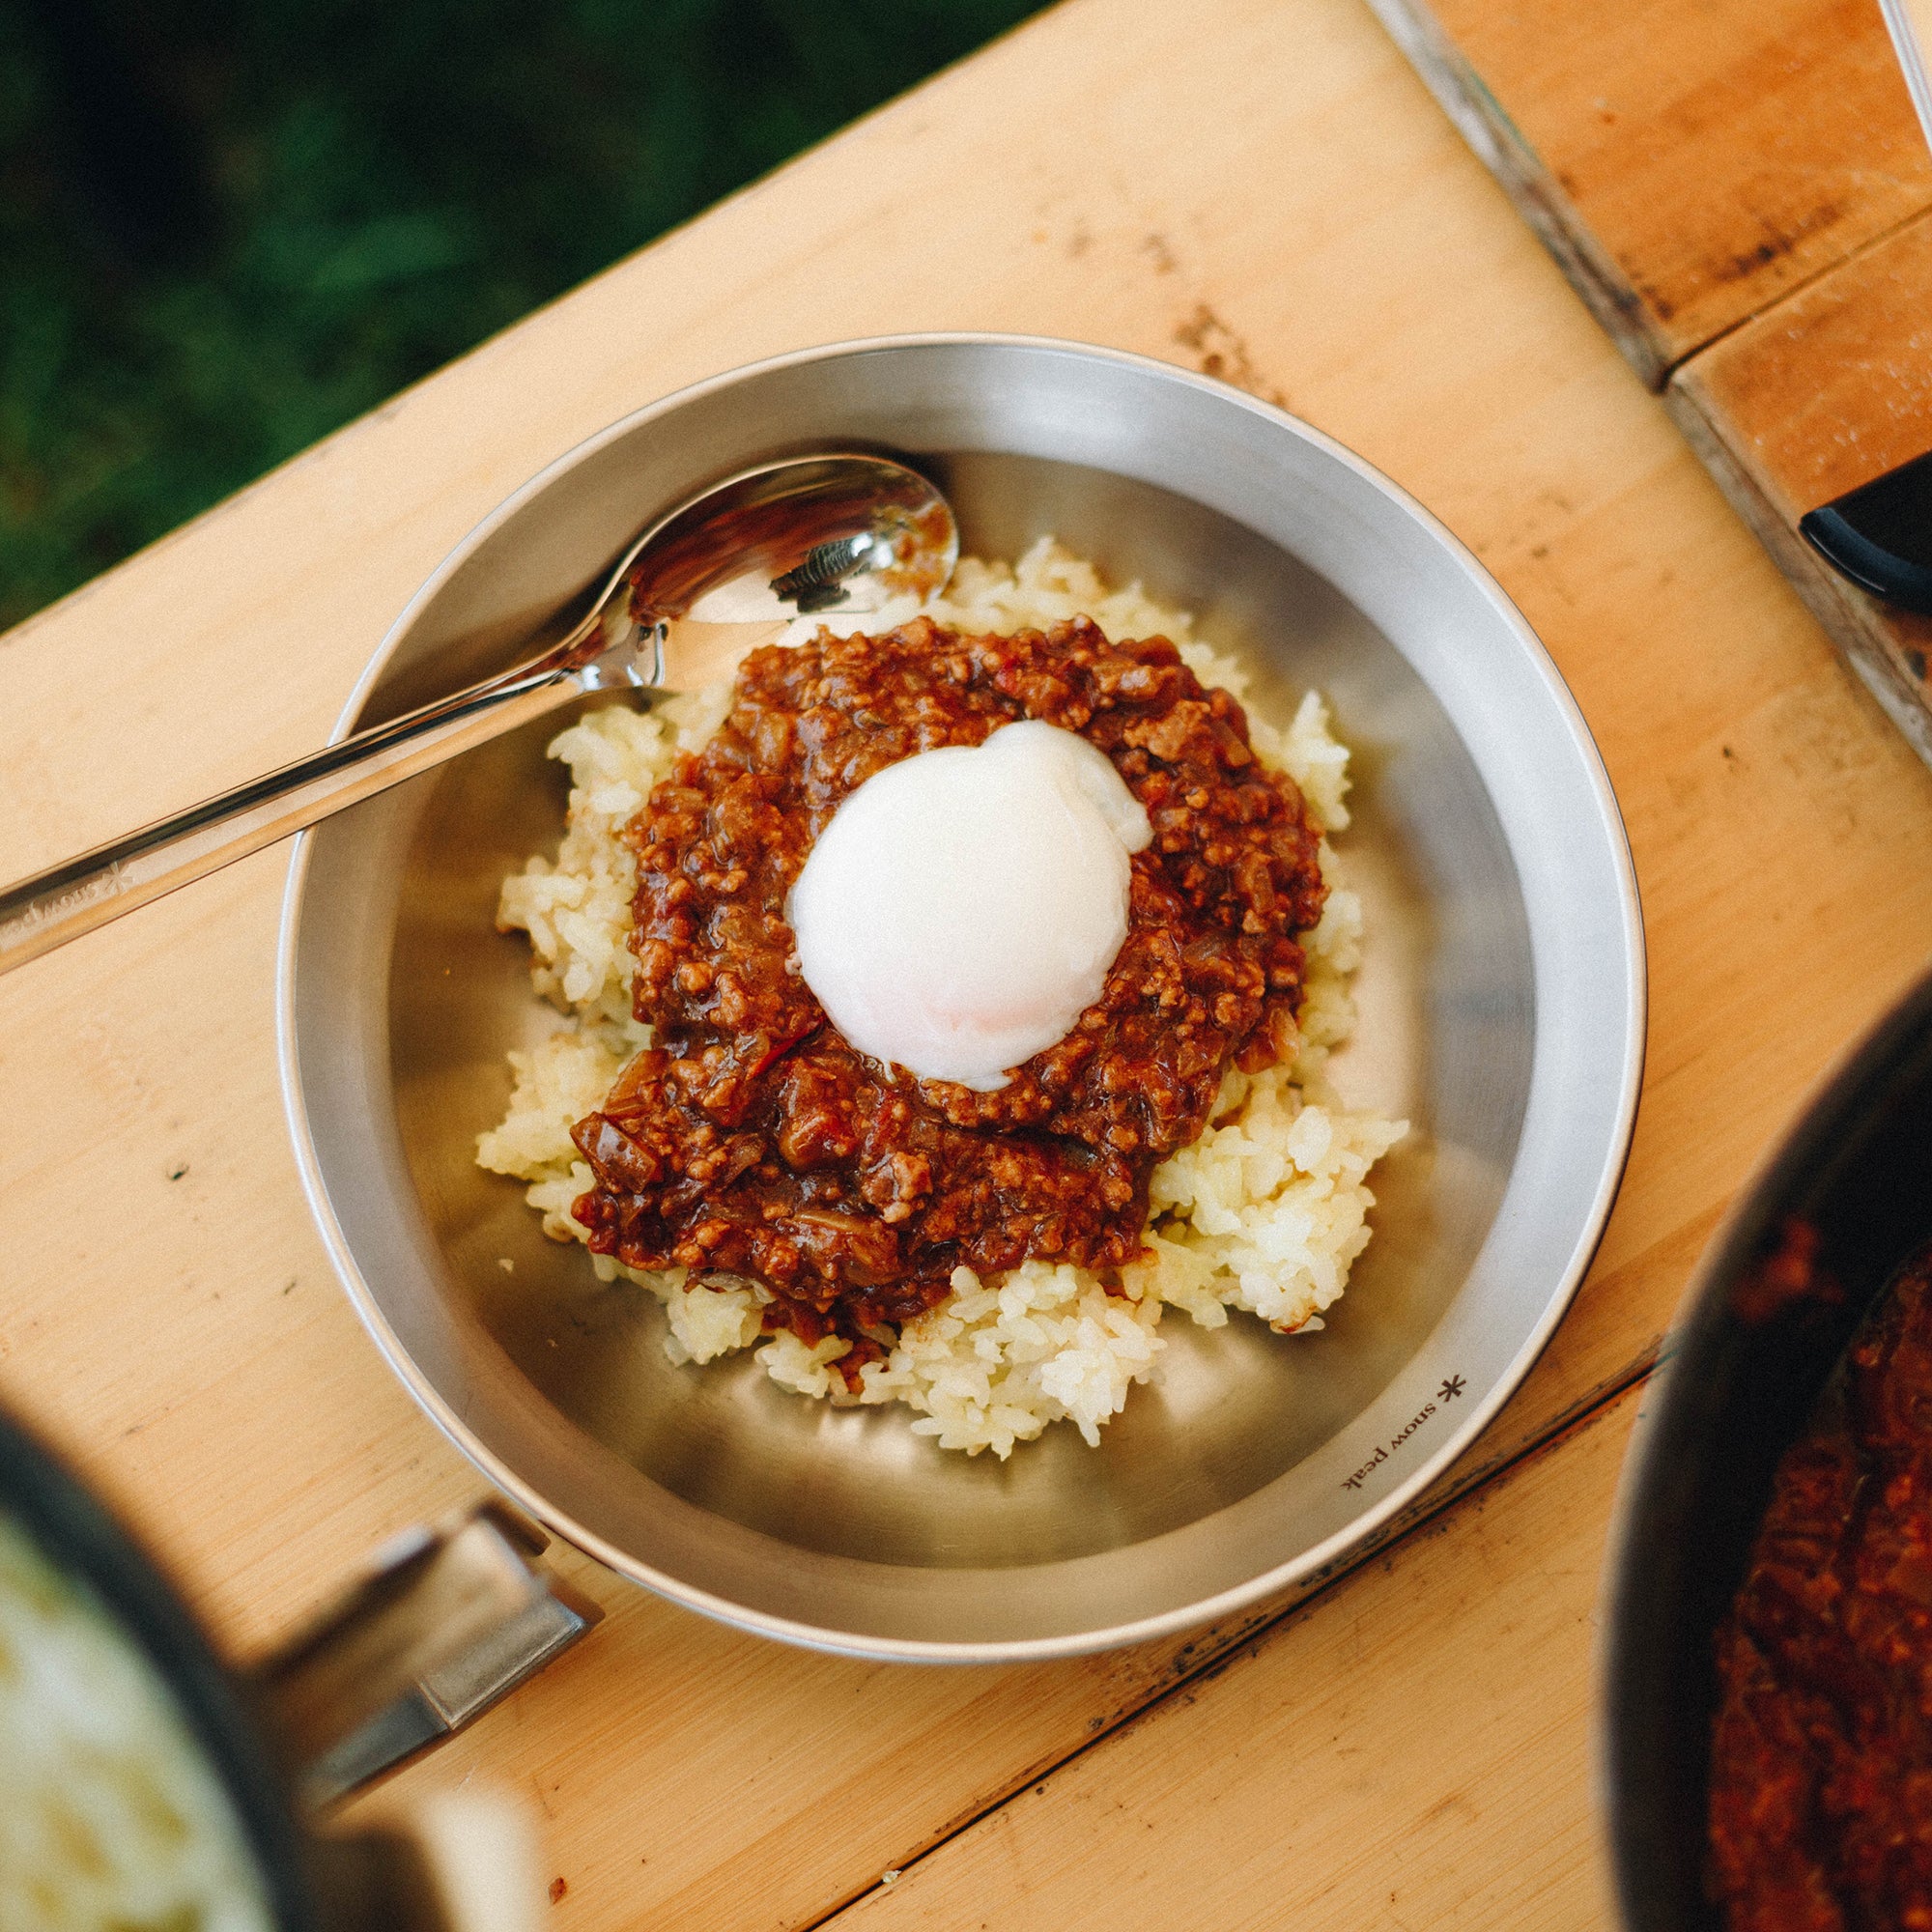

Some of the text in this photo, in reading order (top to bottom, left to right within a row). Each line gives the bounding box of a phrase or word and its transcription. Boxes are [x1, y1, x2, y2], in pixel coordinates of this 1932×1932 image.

[43, 883, 96, 917] snow
[1340, 1403, 1436, 1491] snow peak
